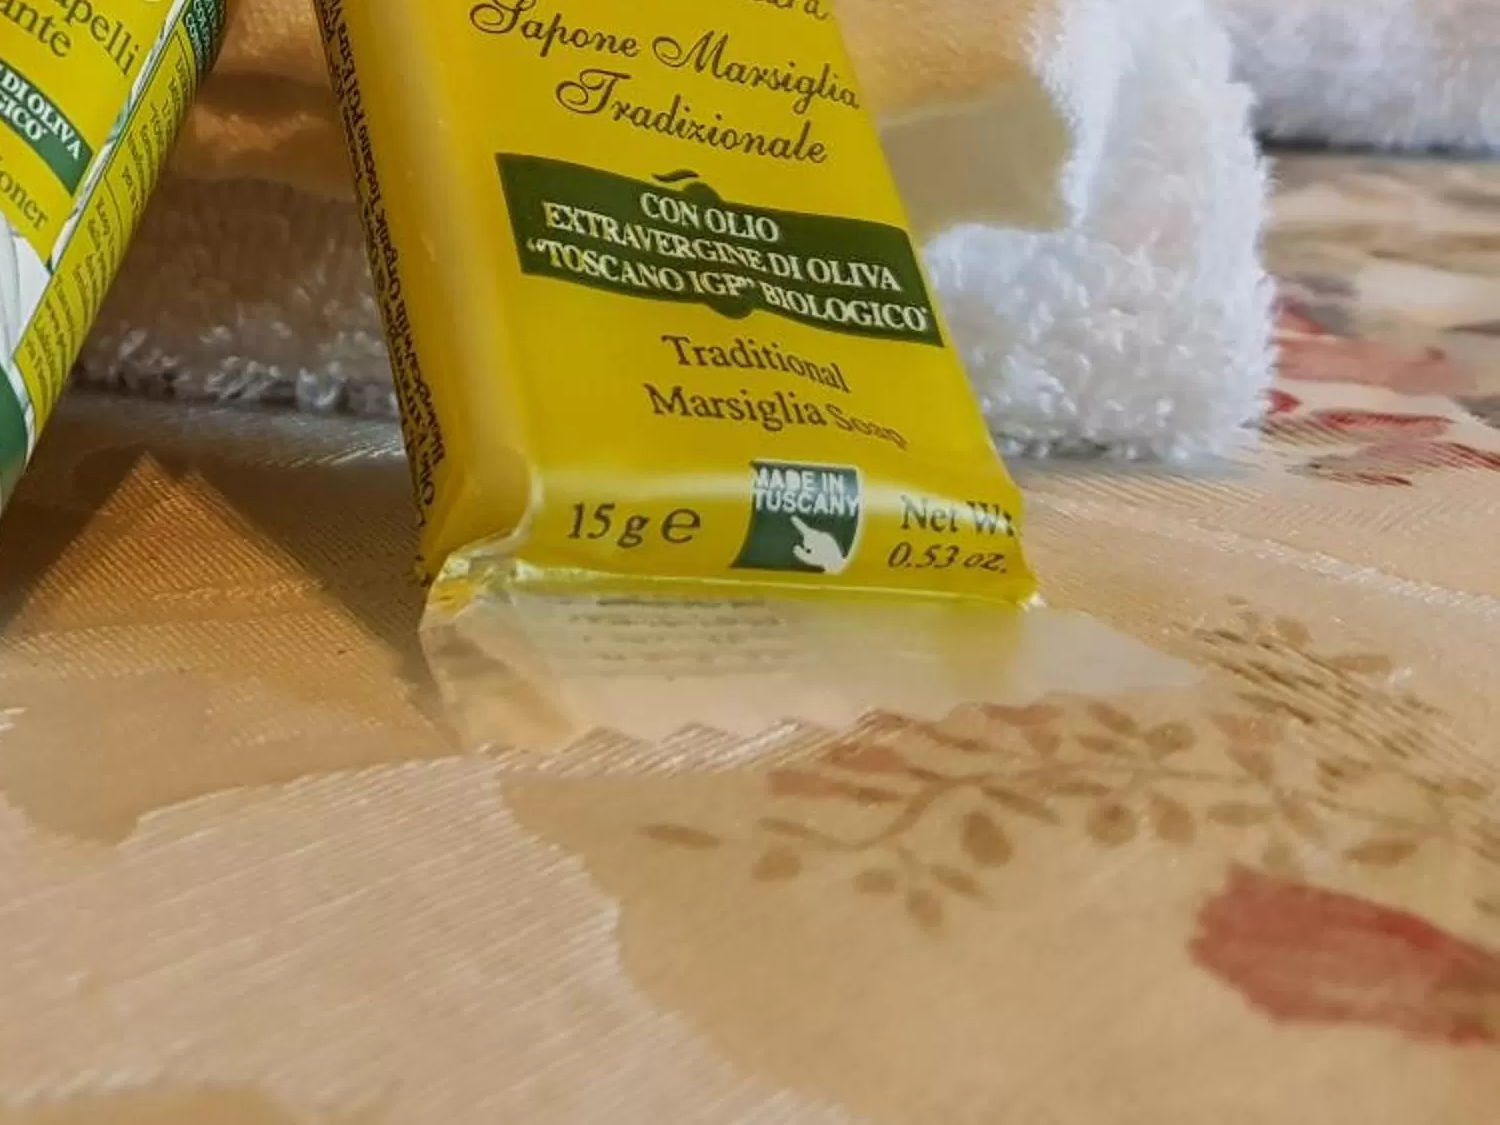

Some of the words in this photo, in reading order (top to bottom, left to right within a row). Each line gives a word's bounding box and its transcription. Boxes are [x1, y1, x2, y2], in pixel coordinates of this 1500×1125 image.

[651, 29, 861, 116] Marsiglia
[26, 92, 83, 162] OLIVA
[554, 67, 830, 166] Tradizionale
[638, 191, 702, 229] CON
[703, 207, 781, 244] OLIO
[540, 200, 769, 273] EXTRAVERGINE
[767, 251, 805, 281] DI
[804, 258, 903, 293] OLIVA
[660, 334, 853, 395] Traditional
[642, 382, 828, 433] Marsiglia
[751, 466, 820, 493] MADE
[820, 471, 846, 493] IN
[752, 488, 862, 517] TUSCANY
[900, 494, 959, 534] Net
[886, 540, 961, 569] 0.53
[962, 551, 1008, 574] oz.
